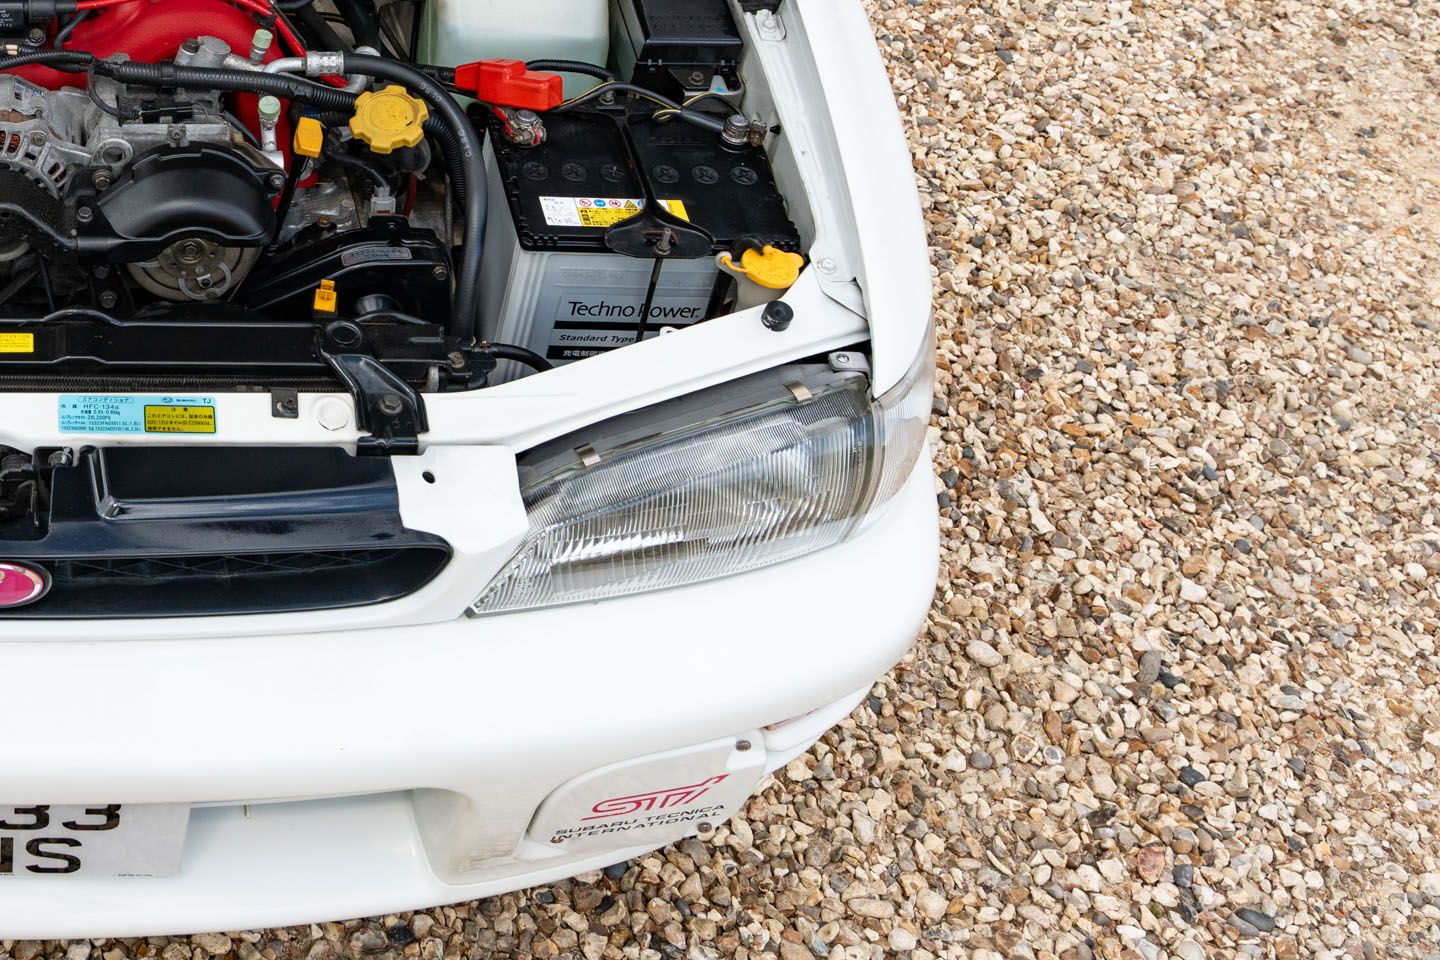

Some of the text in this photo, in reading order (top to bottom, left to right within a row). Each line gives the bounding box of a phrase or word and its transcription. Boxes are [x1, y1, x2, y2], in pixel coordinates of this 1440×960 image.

[568, 300, 635, 317] Techno
[559, 334, 635, 343] Standard Type
[551, 811, 722, 841] INTERNATIONAL
[555, 804, 725, 835] SUBARU TECNICA
